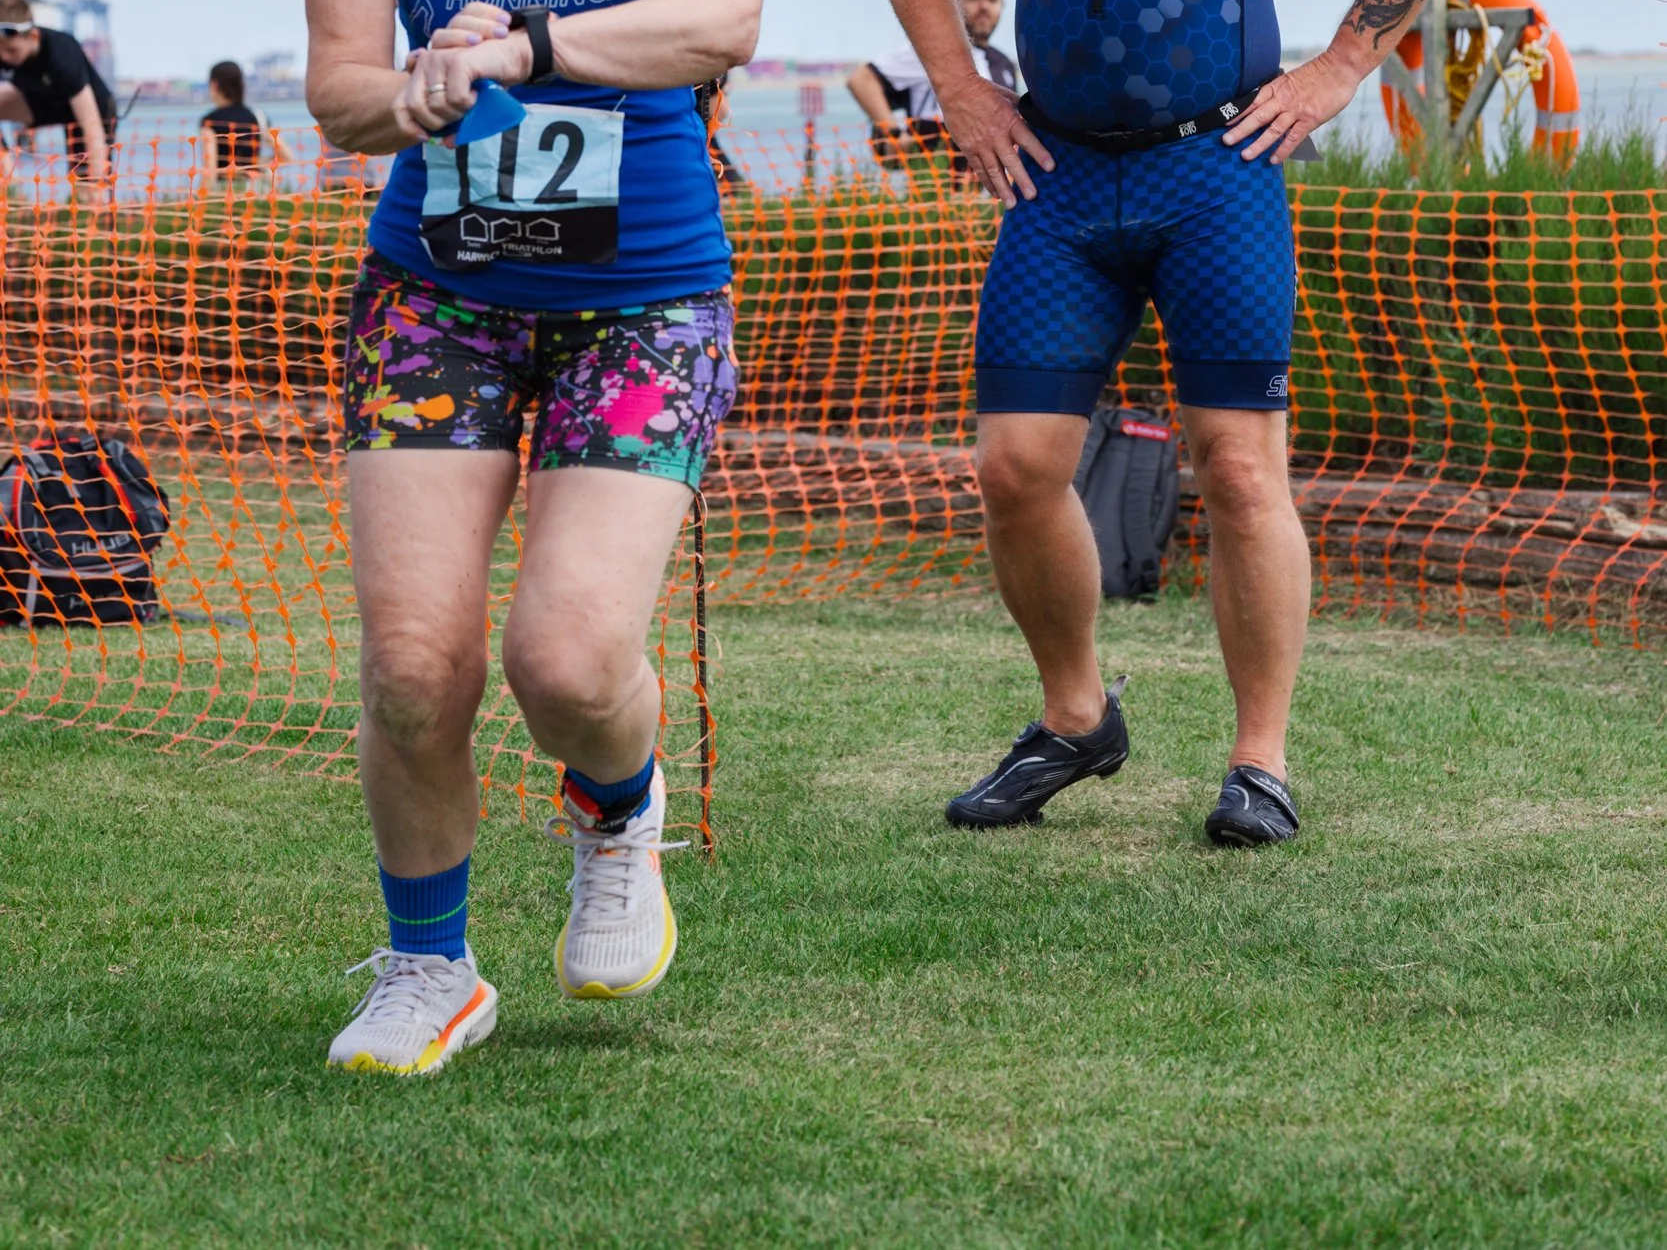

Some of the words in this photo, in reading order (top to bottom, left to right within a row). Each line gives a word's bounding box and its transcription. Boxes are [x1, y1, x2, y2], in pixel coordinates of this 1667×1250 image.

[455, 120, 584, 207] 112
[501, 242, 562, 255] TRIATHLON
[72, 533, 131, 554] HUUB
